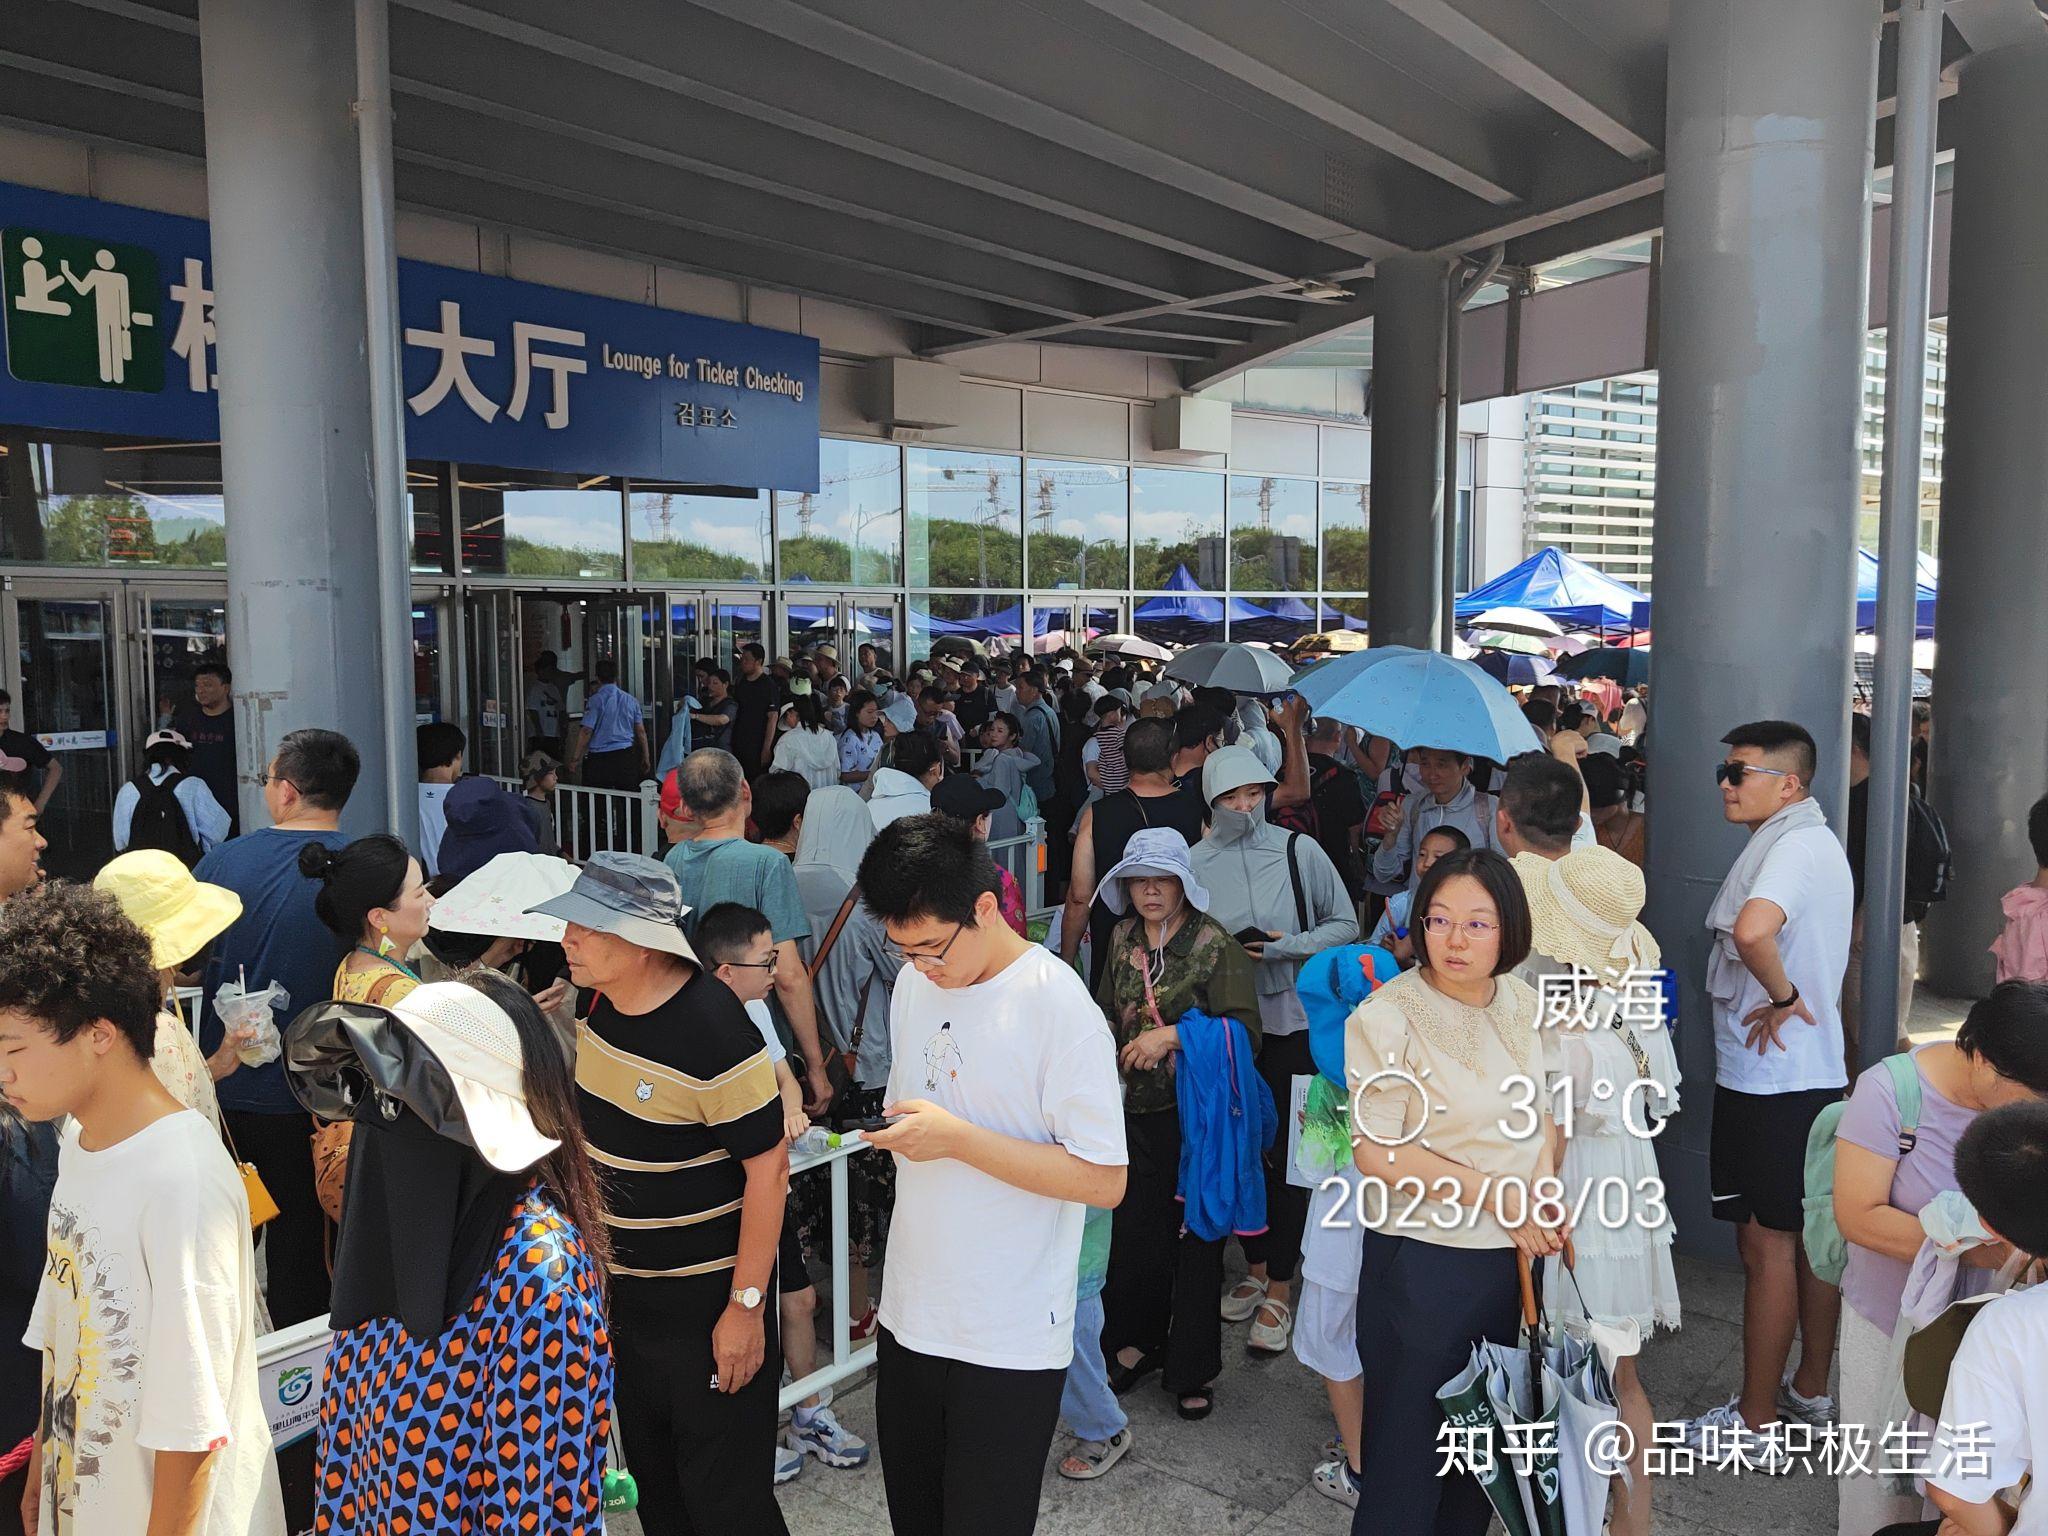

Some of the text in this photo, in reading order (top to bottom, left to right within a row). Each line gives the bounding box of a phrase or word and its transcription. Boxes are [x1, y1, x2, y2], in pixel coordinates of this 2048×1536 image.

[602, 343, 804, 402] Lounge for Ticket Checking
[677, 402, 738, 429] 검표소
